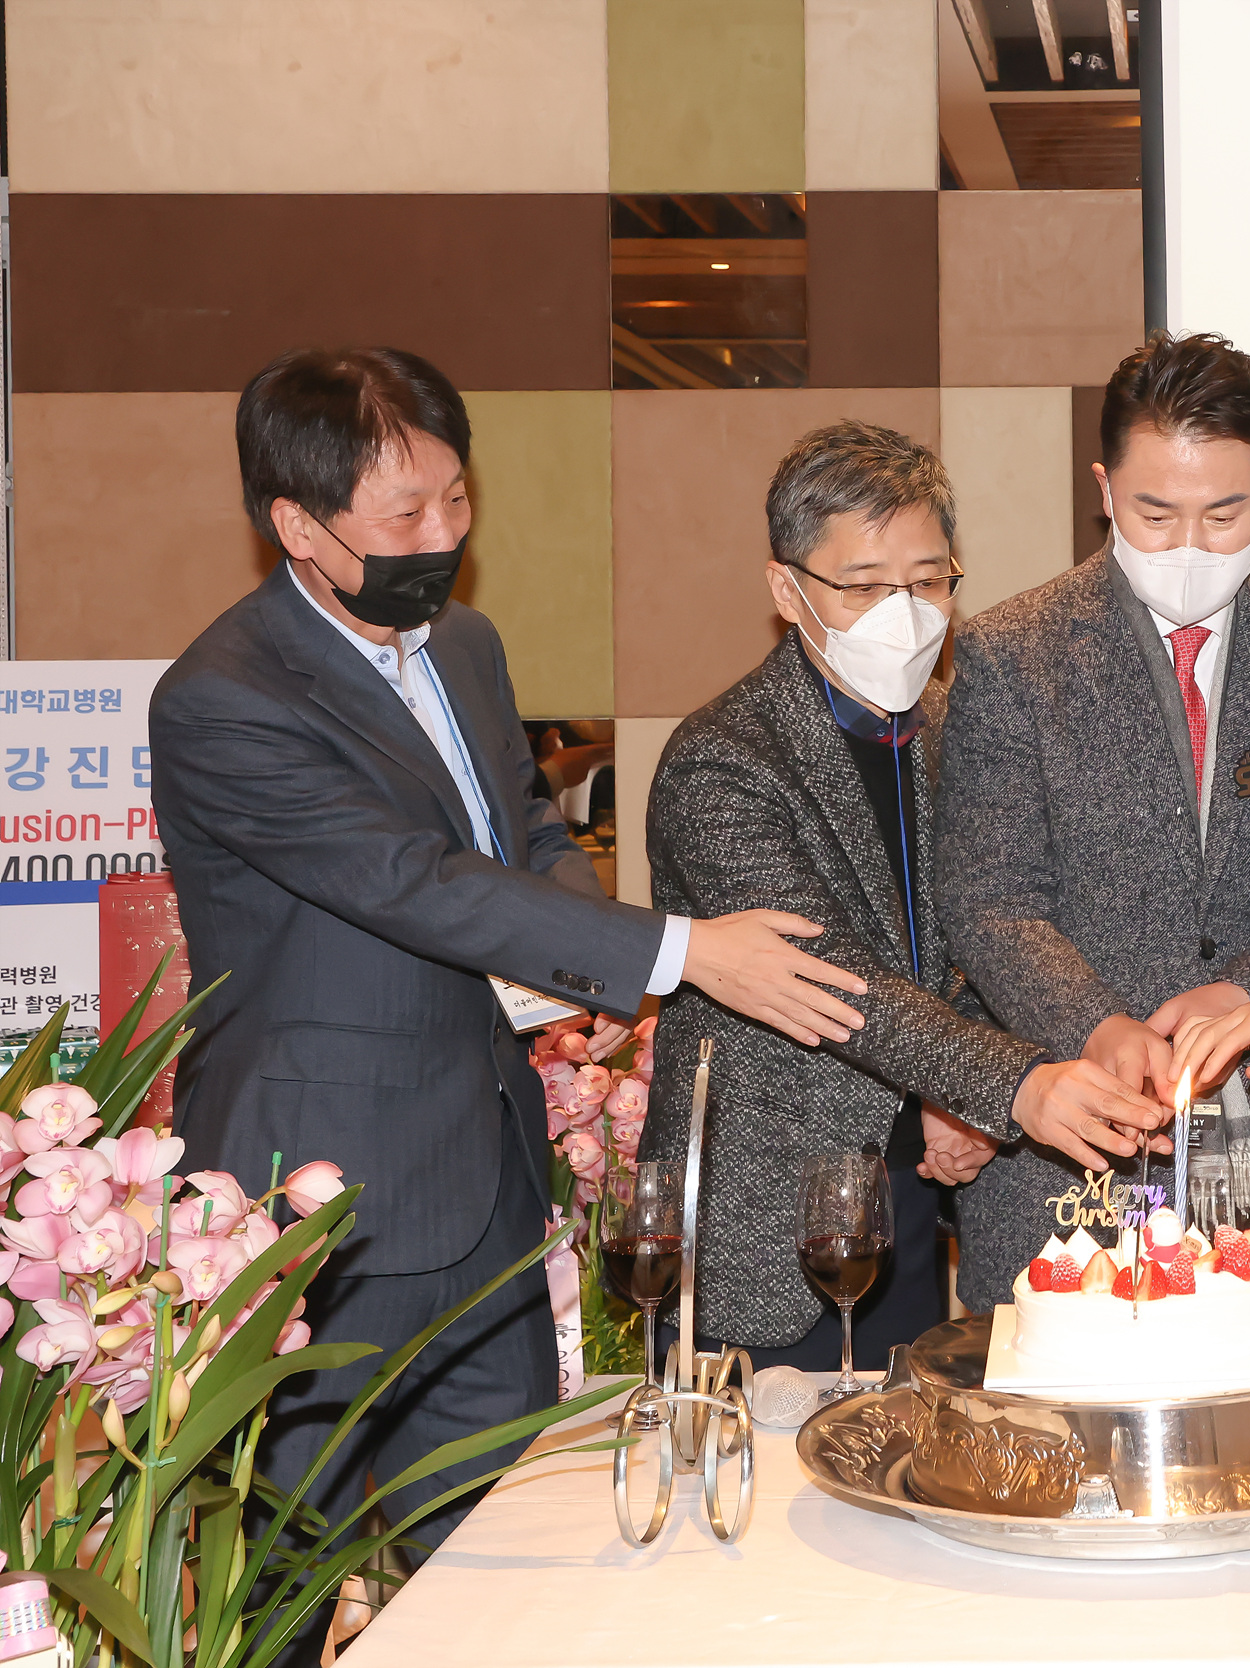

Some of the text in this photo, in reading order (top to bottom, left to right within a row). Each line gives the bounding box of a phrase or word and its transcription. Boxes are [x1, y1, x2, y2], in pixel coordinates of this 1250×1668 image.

[0, 965, 57, 986] 력병원
[25, 994, 62, 1015] 촬영
[1069, 1169, 1167, 1211] Merry
